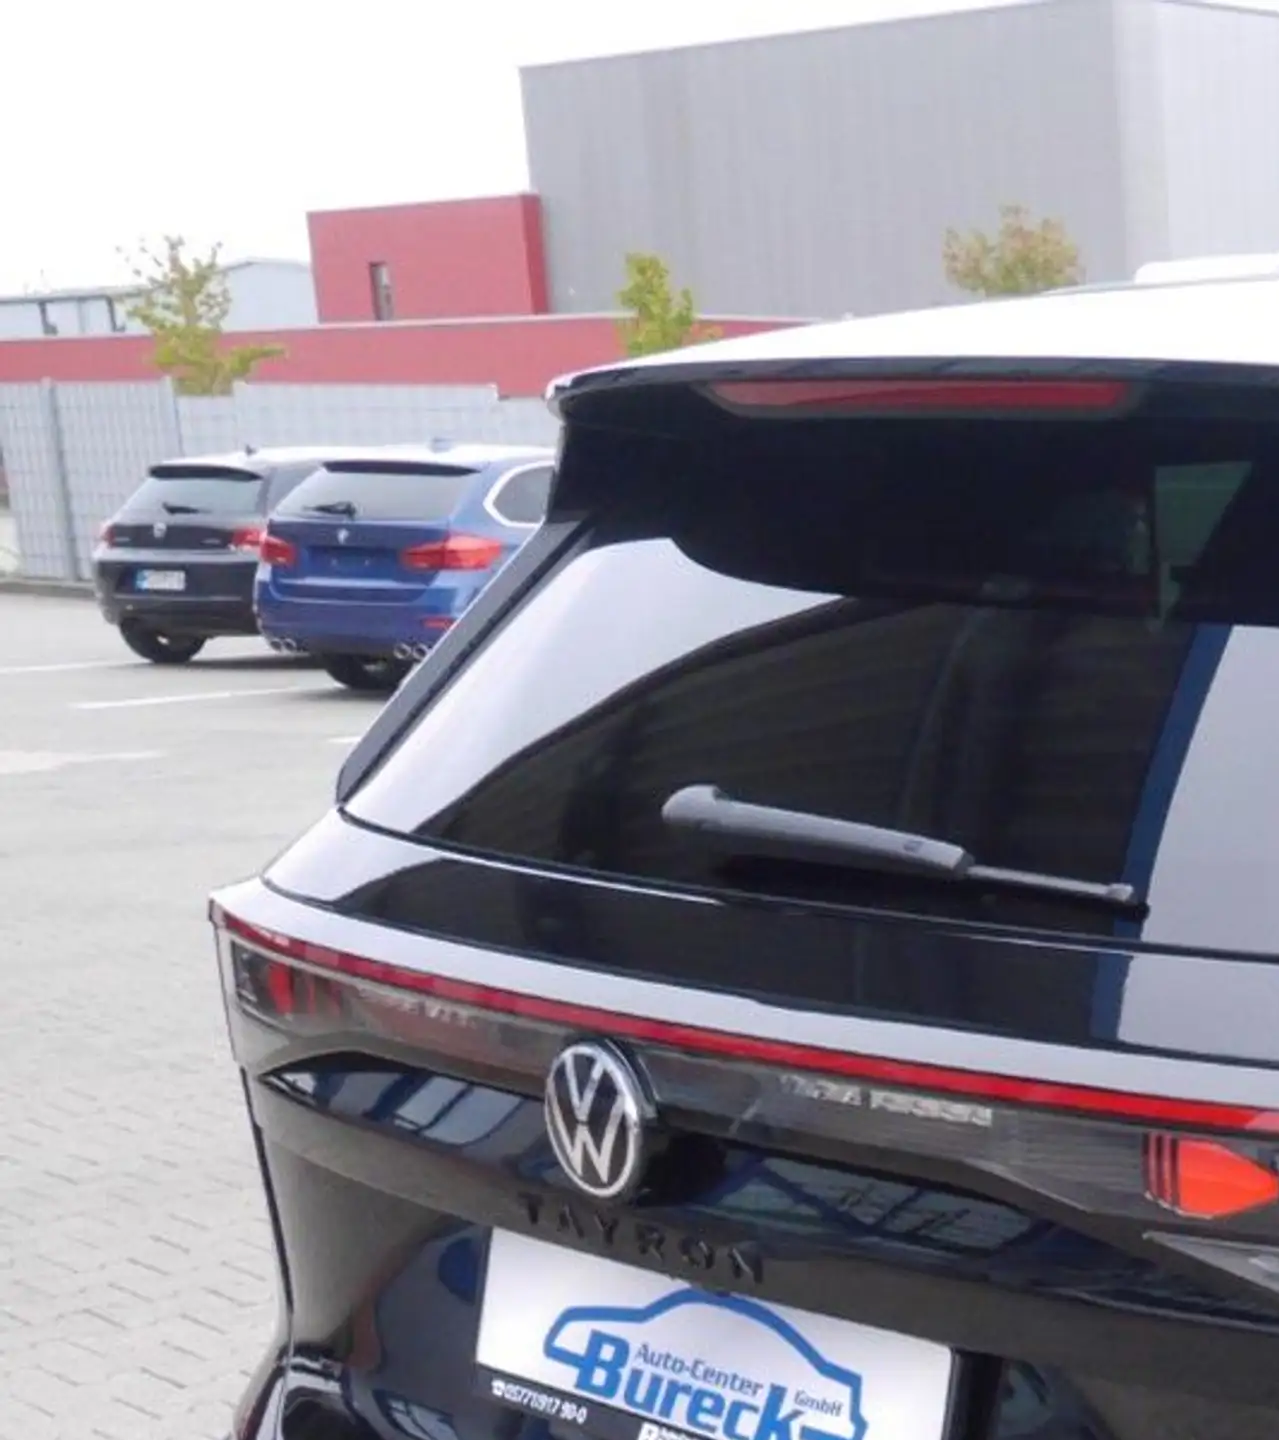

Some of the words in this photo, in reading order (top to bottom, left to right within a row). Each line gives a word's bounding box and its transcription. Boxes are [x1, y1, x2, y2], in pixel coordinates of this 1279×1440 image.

[518, 1192, 766, 1285] TAYRON
[634, 1344, 764, 1396] Auto-Center
[792, 1389, 844, 1417] GmbH
